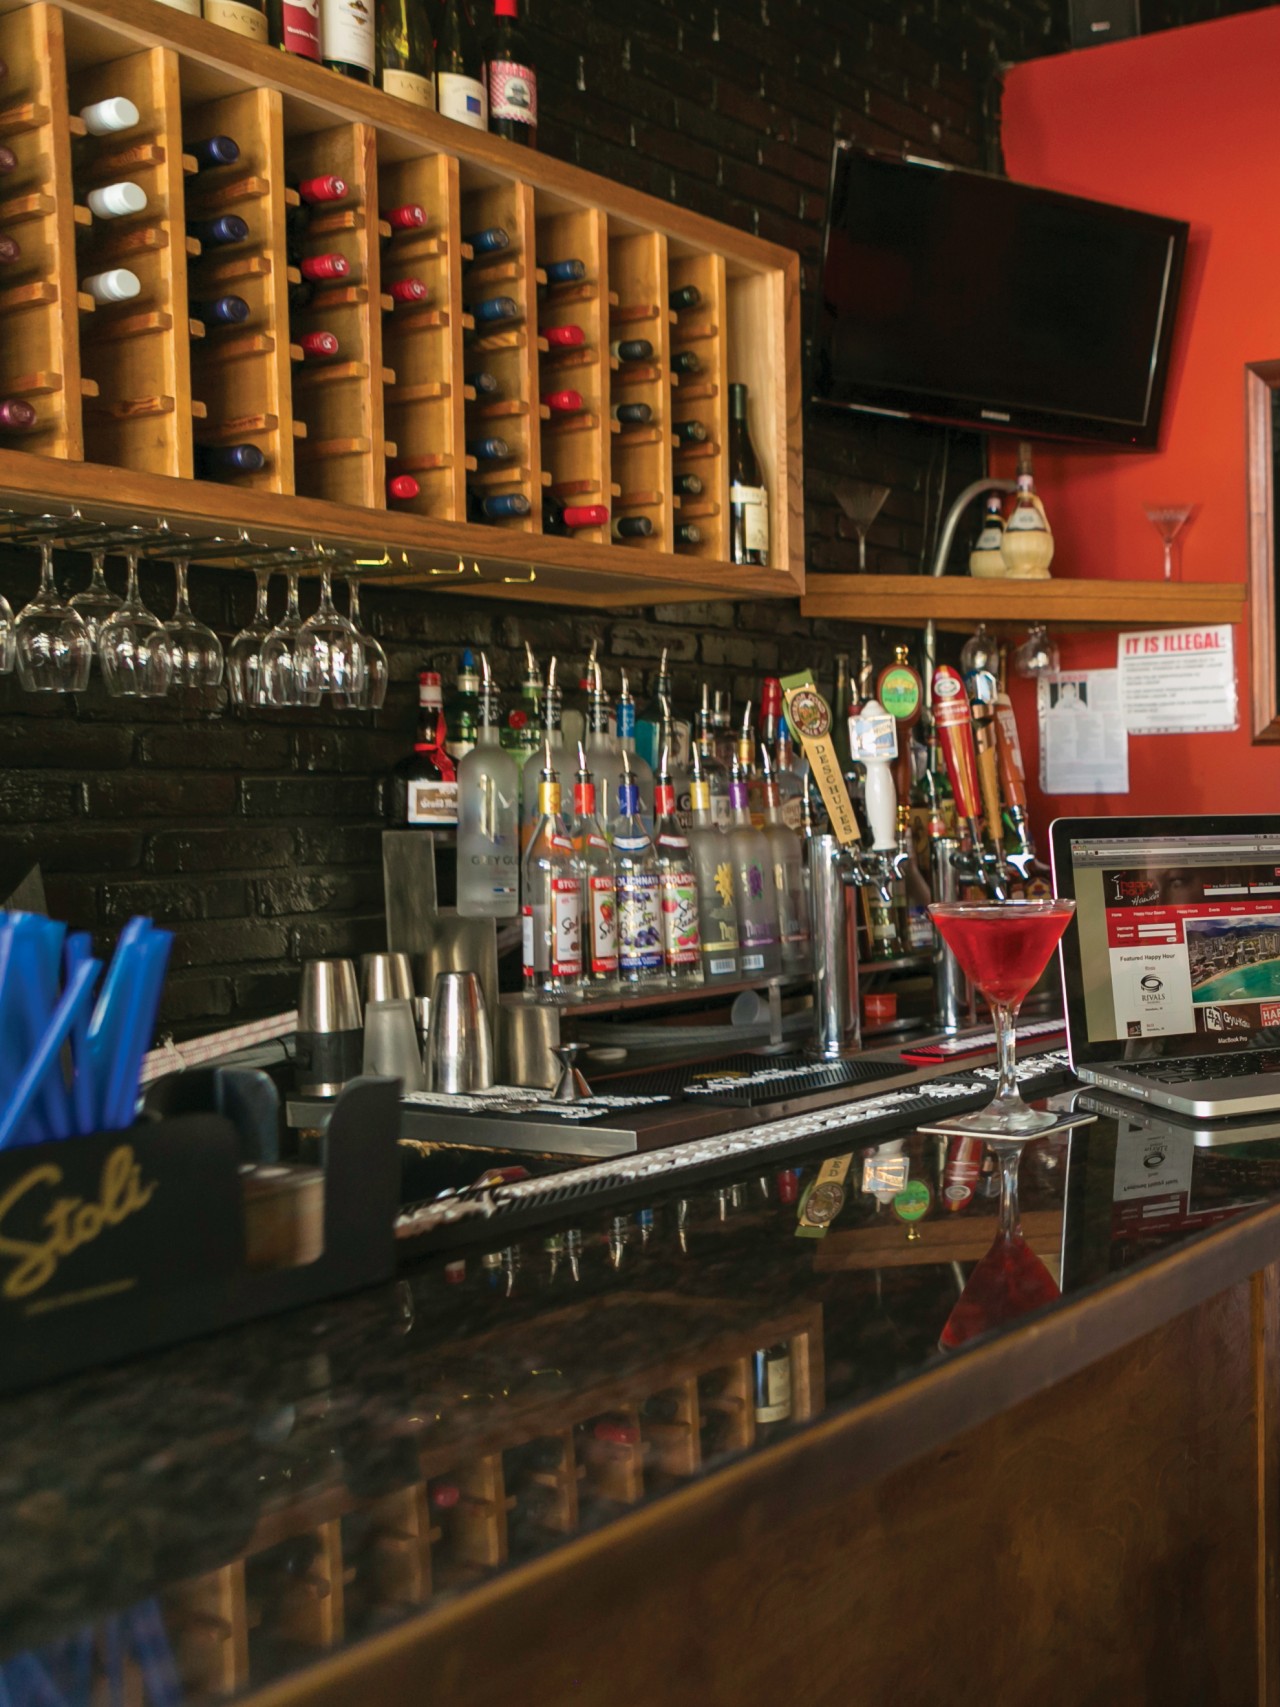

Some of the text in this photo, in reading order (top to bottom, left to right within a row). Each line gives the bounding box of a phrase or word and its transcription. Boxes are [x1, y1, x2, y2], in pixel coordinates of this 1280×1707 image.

[1126, 637, 1140, 655] IT
[1144, 636, 1159, 653] IS
[815, 744, 853, 835] DESCHUTES
[1141, 993, 1166, 1002] RIVALS
[0, 1144, 158, 1297] Stoli
